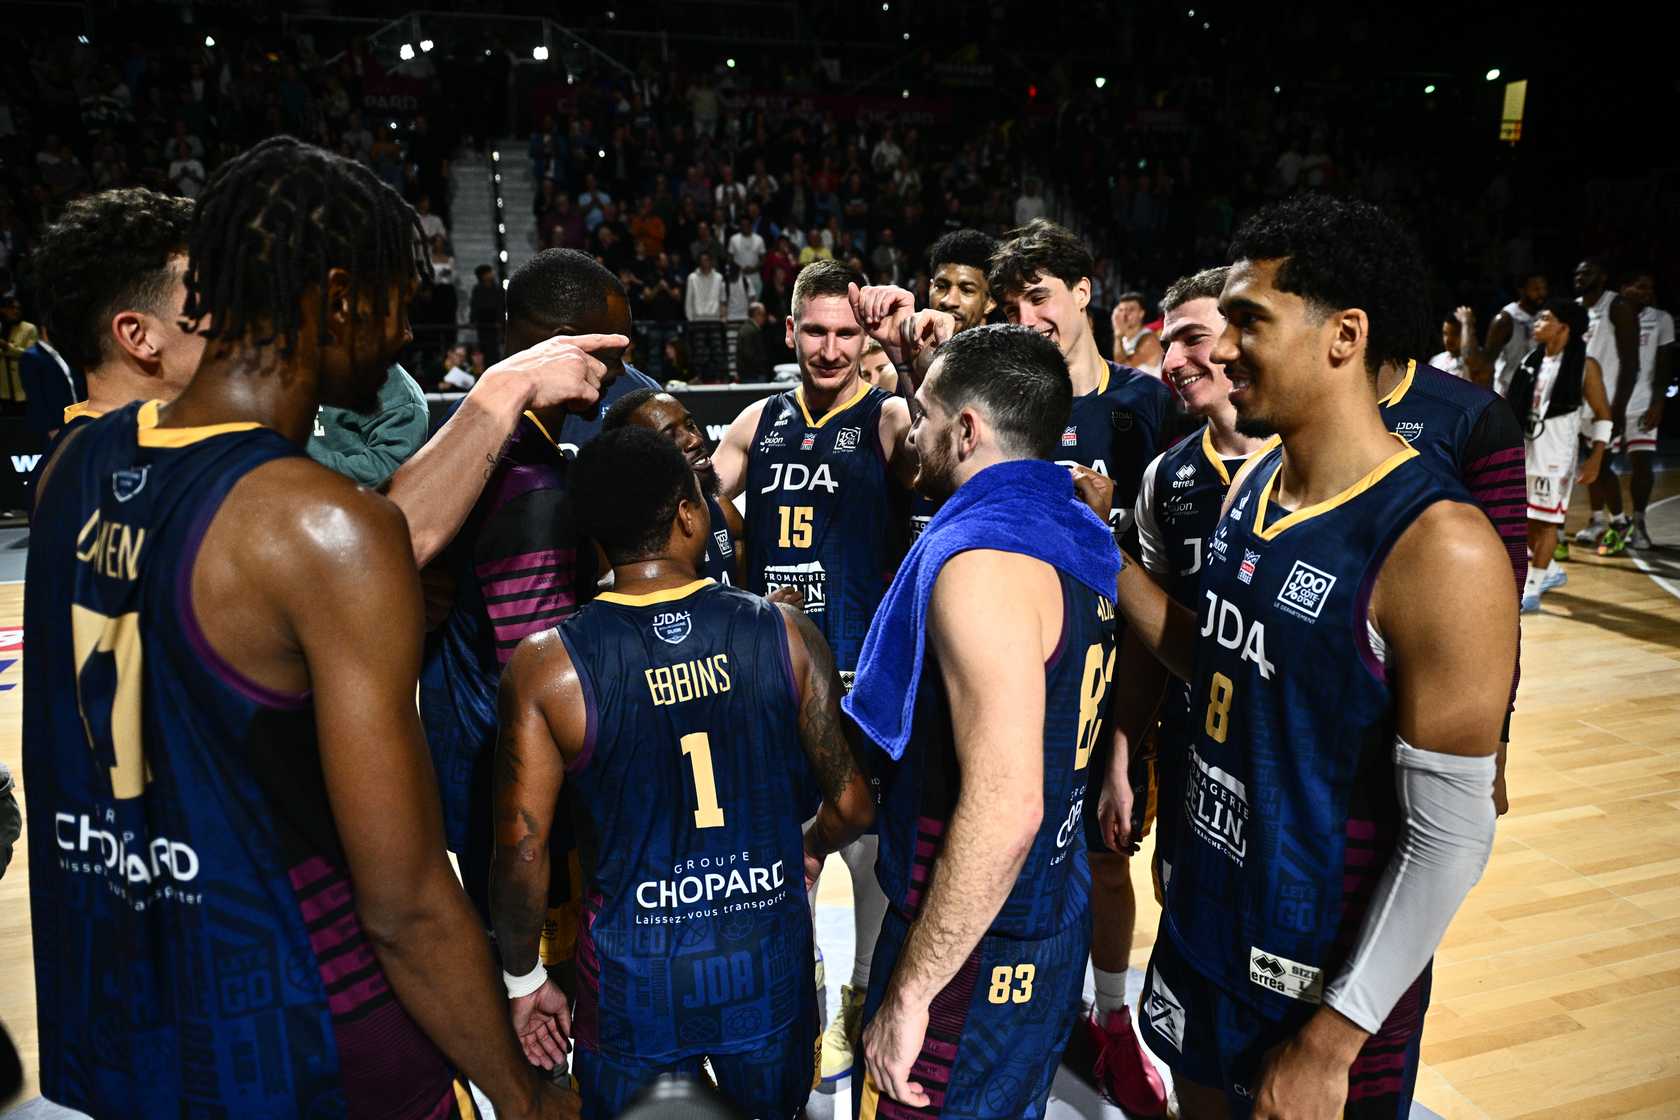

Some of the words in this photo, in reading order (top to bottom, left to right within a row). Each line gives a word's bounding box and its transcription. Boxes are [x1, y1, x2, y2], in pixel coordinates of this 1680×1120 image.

[761, 464, 839, 494] JDA
[1172, 479, 1195, 489] errea
[778, 505, 814, 549] 15
[1284, 582, 1302, 600] %
[1295, 569, 1327, 594] 100
[1200, 589, 1276, 681] JDA
[644, 653, 731, 706] EBBINS
[1205, 671, 1234, 744] 8
[680, 731, 725, 829] 1
[674, 851, 750, 875] GROUPE
[636, 859, 785, 909] CHOPARD
[636, 908, 719, 926] Laissez-vous
[988, 963, 1037, 1005] 83
[1251, 971, 1286, 992] errea
